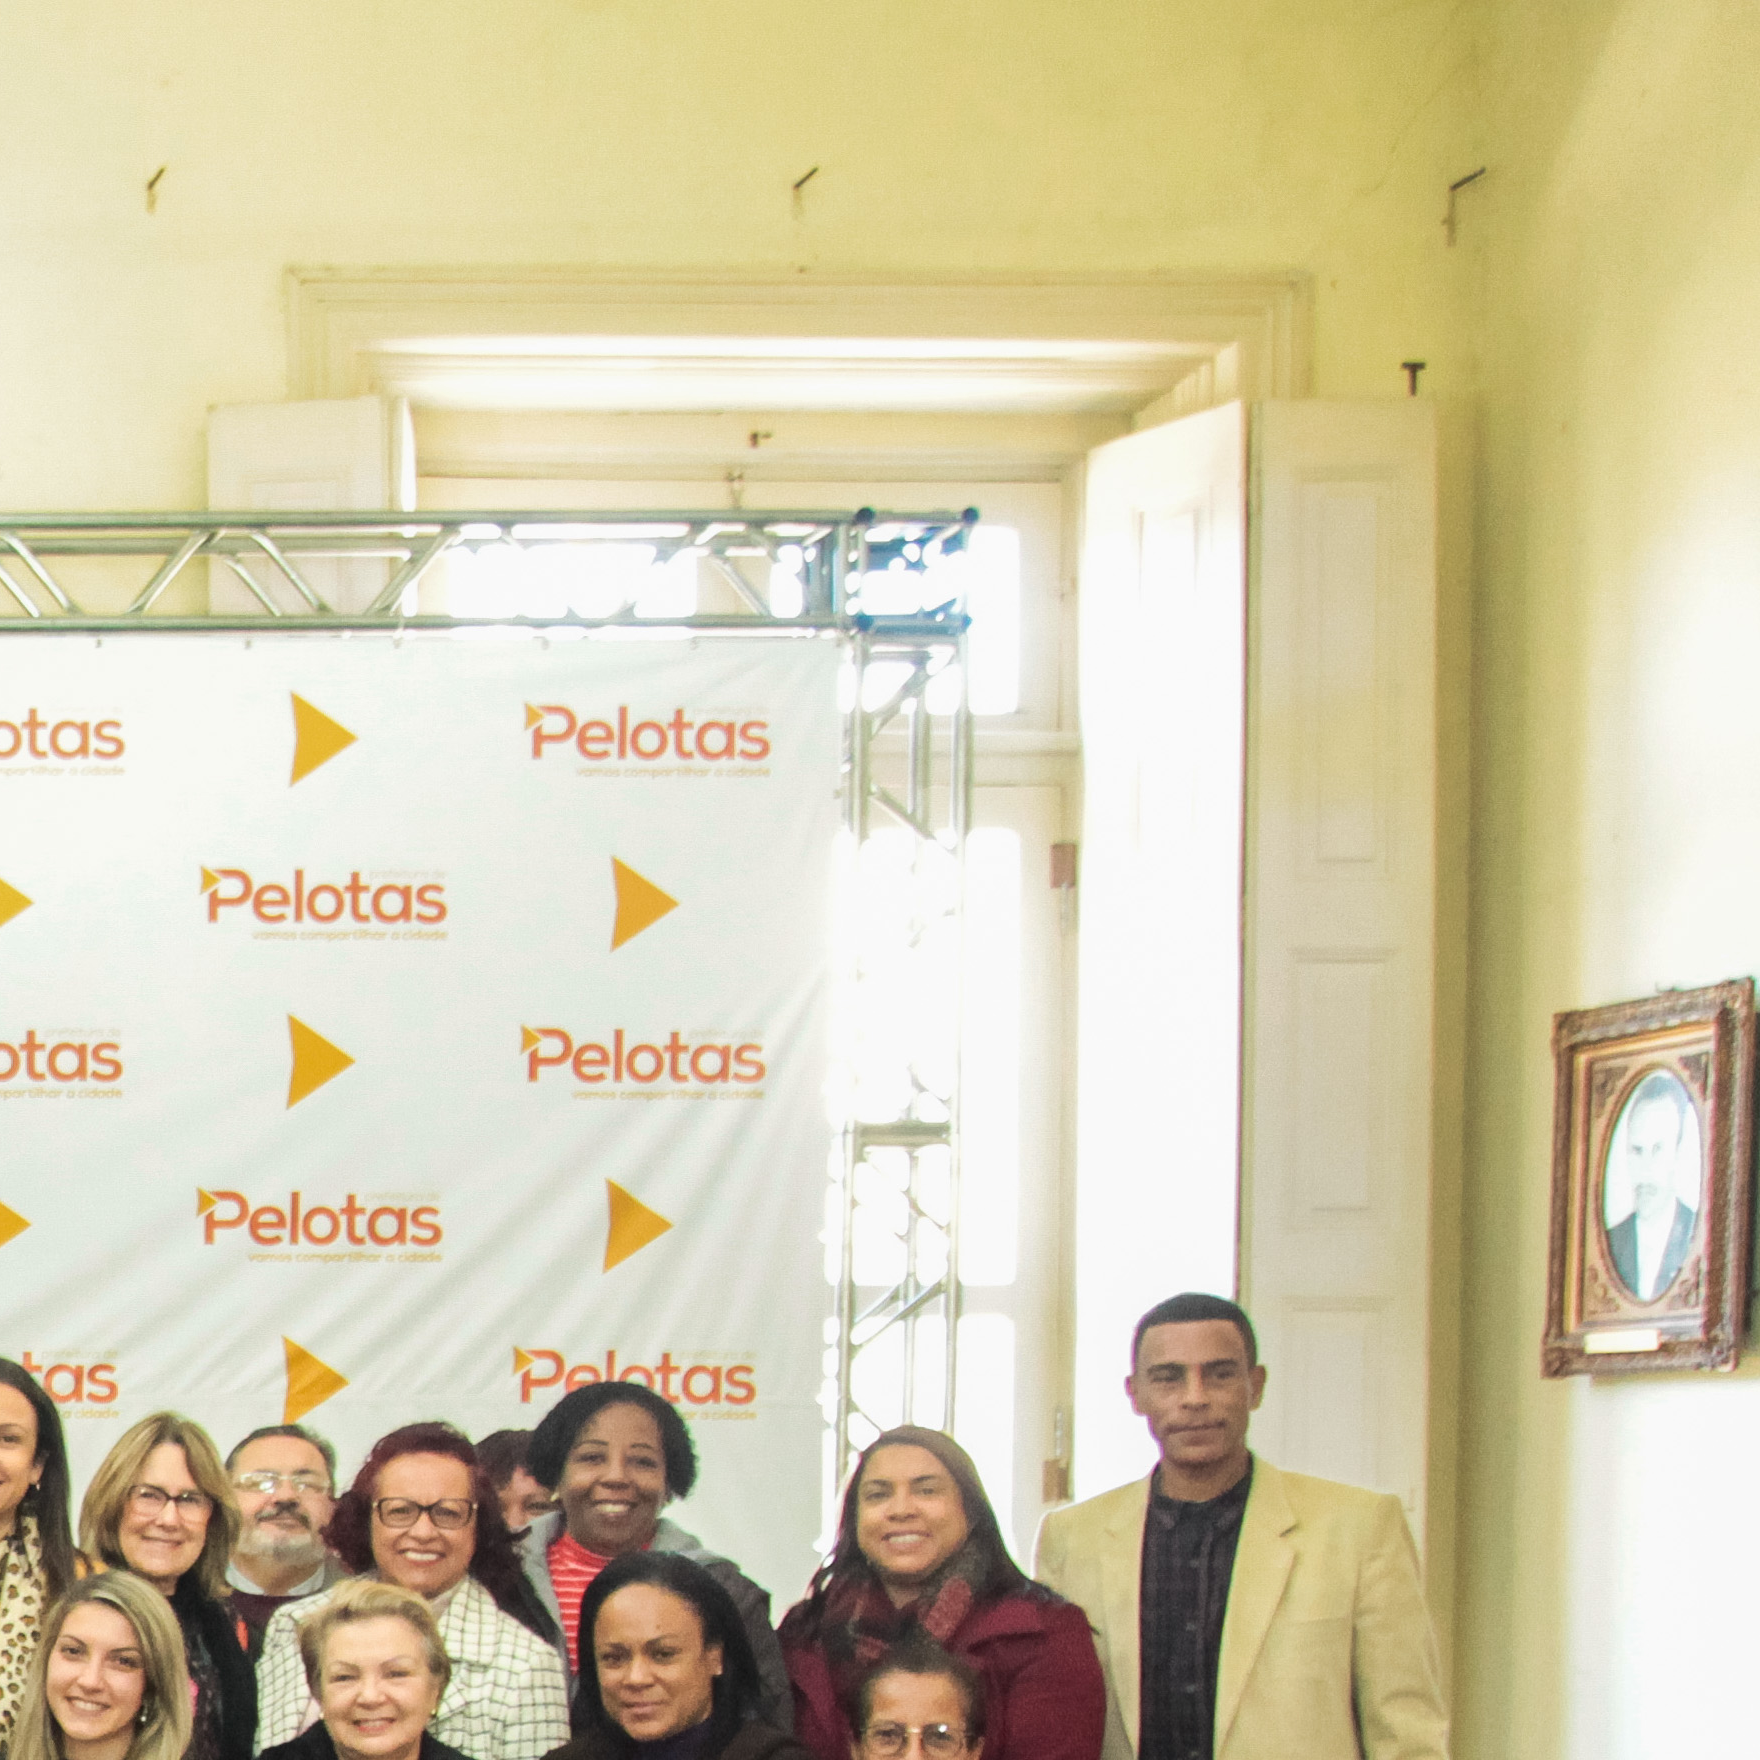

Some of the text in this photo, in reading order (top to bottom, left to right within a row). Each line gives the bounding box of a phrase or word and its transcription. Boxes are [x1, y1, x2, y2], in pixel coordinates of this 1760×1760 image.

[532, 704, 773, 762] Pelotas
[208, 867, 449, 925] Pelotas
[252, 931, 297, 940] vamos
[300, 928, 388, 943] compartilhar
[402, 929, 449, 941] cidade
[528, 1027, 768, 1085] Pelotas
[78, 1087, 124, 1099] cidade
[204, 1189, 445, 1247] Pelotas
[248, 1253, 293, 1262] vamos
[295, 1250, 383, 1265] compartilhar
[397, 1251, 443, 1263] cidade
[73, 1410, 120, 1422] cidade
